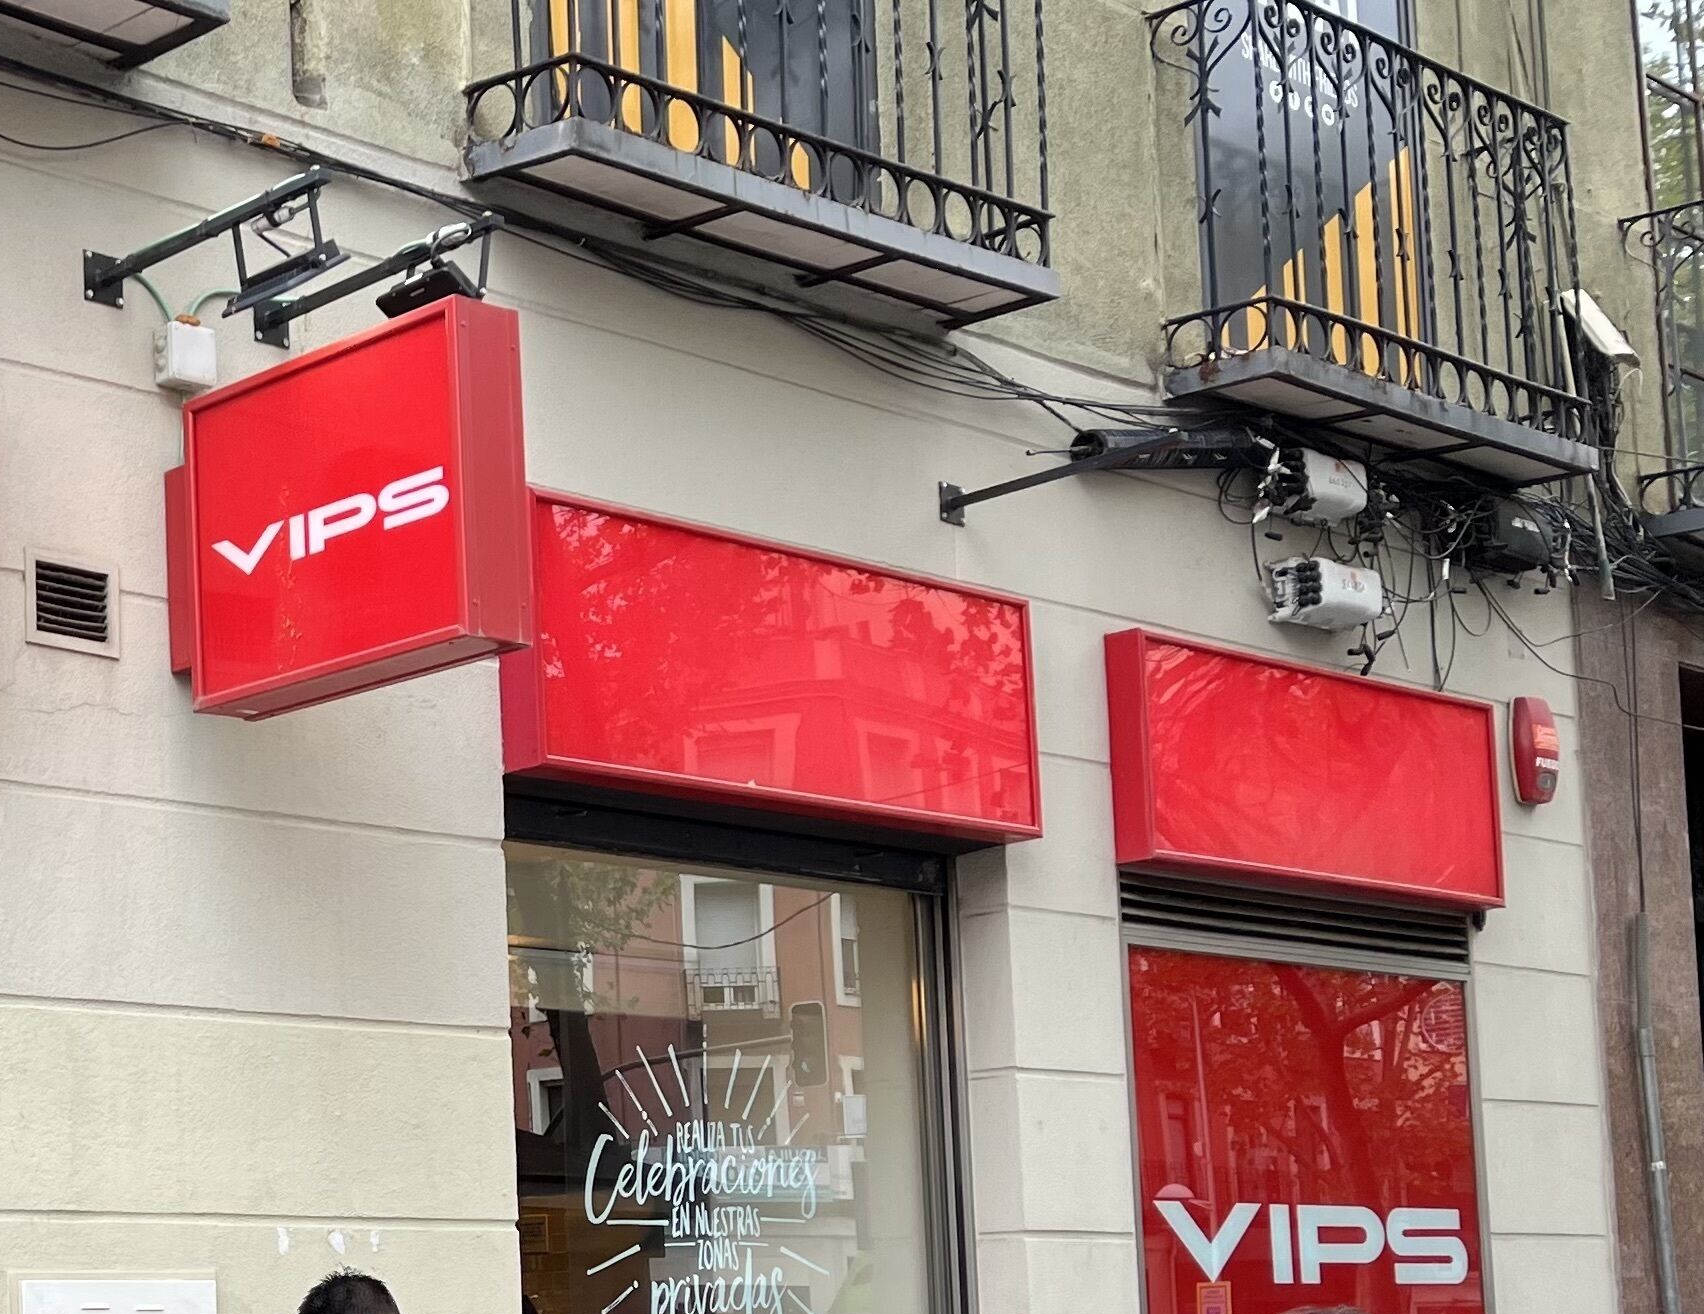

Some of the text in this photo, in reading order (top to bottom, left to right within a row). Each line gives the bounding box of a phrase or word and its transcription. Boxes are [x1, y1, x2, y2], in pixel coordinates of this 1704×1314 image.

[211, 464, 450, 576] VIPS
[675, 1121, 725, 1154] REALIZA
[730, 1122, 756, 1154] TUS
[583, 1128, 817, 1225] Celebraciones
[671, 1202, 761, 1238] EN NUESTRAS
[1152, 1199, 1470, 1286] VIPS
[697, 1239, 740, 1272] ZONAS
